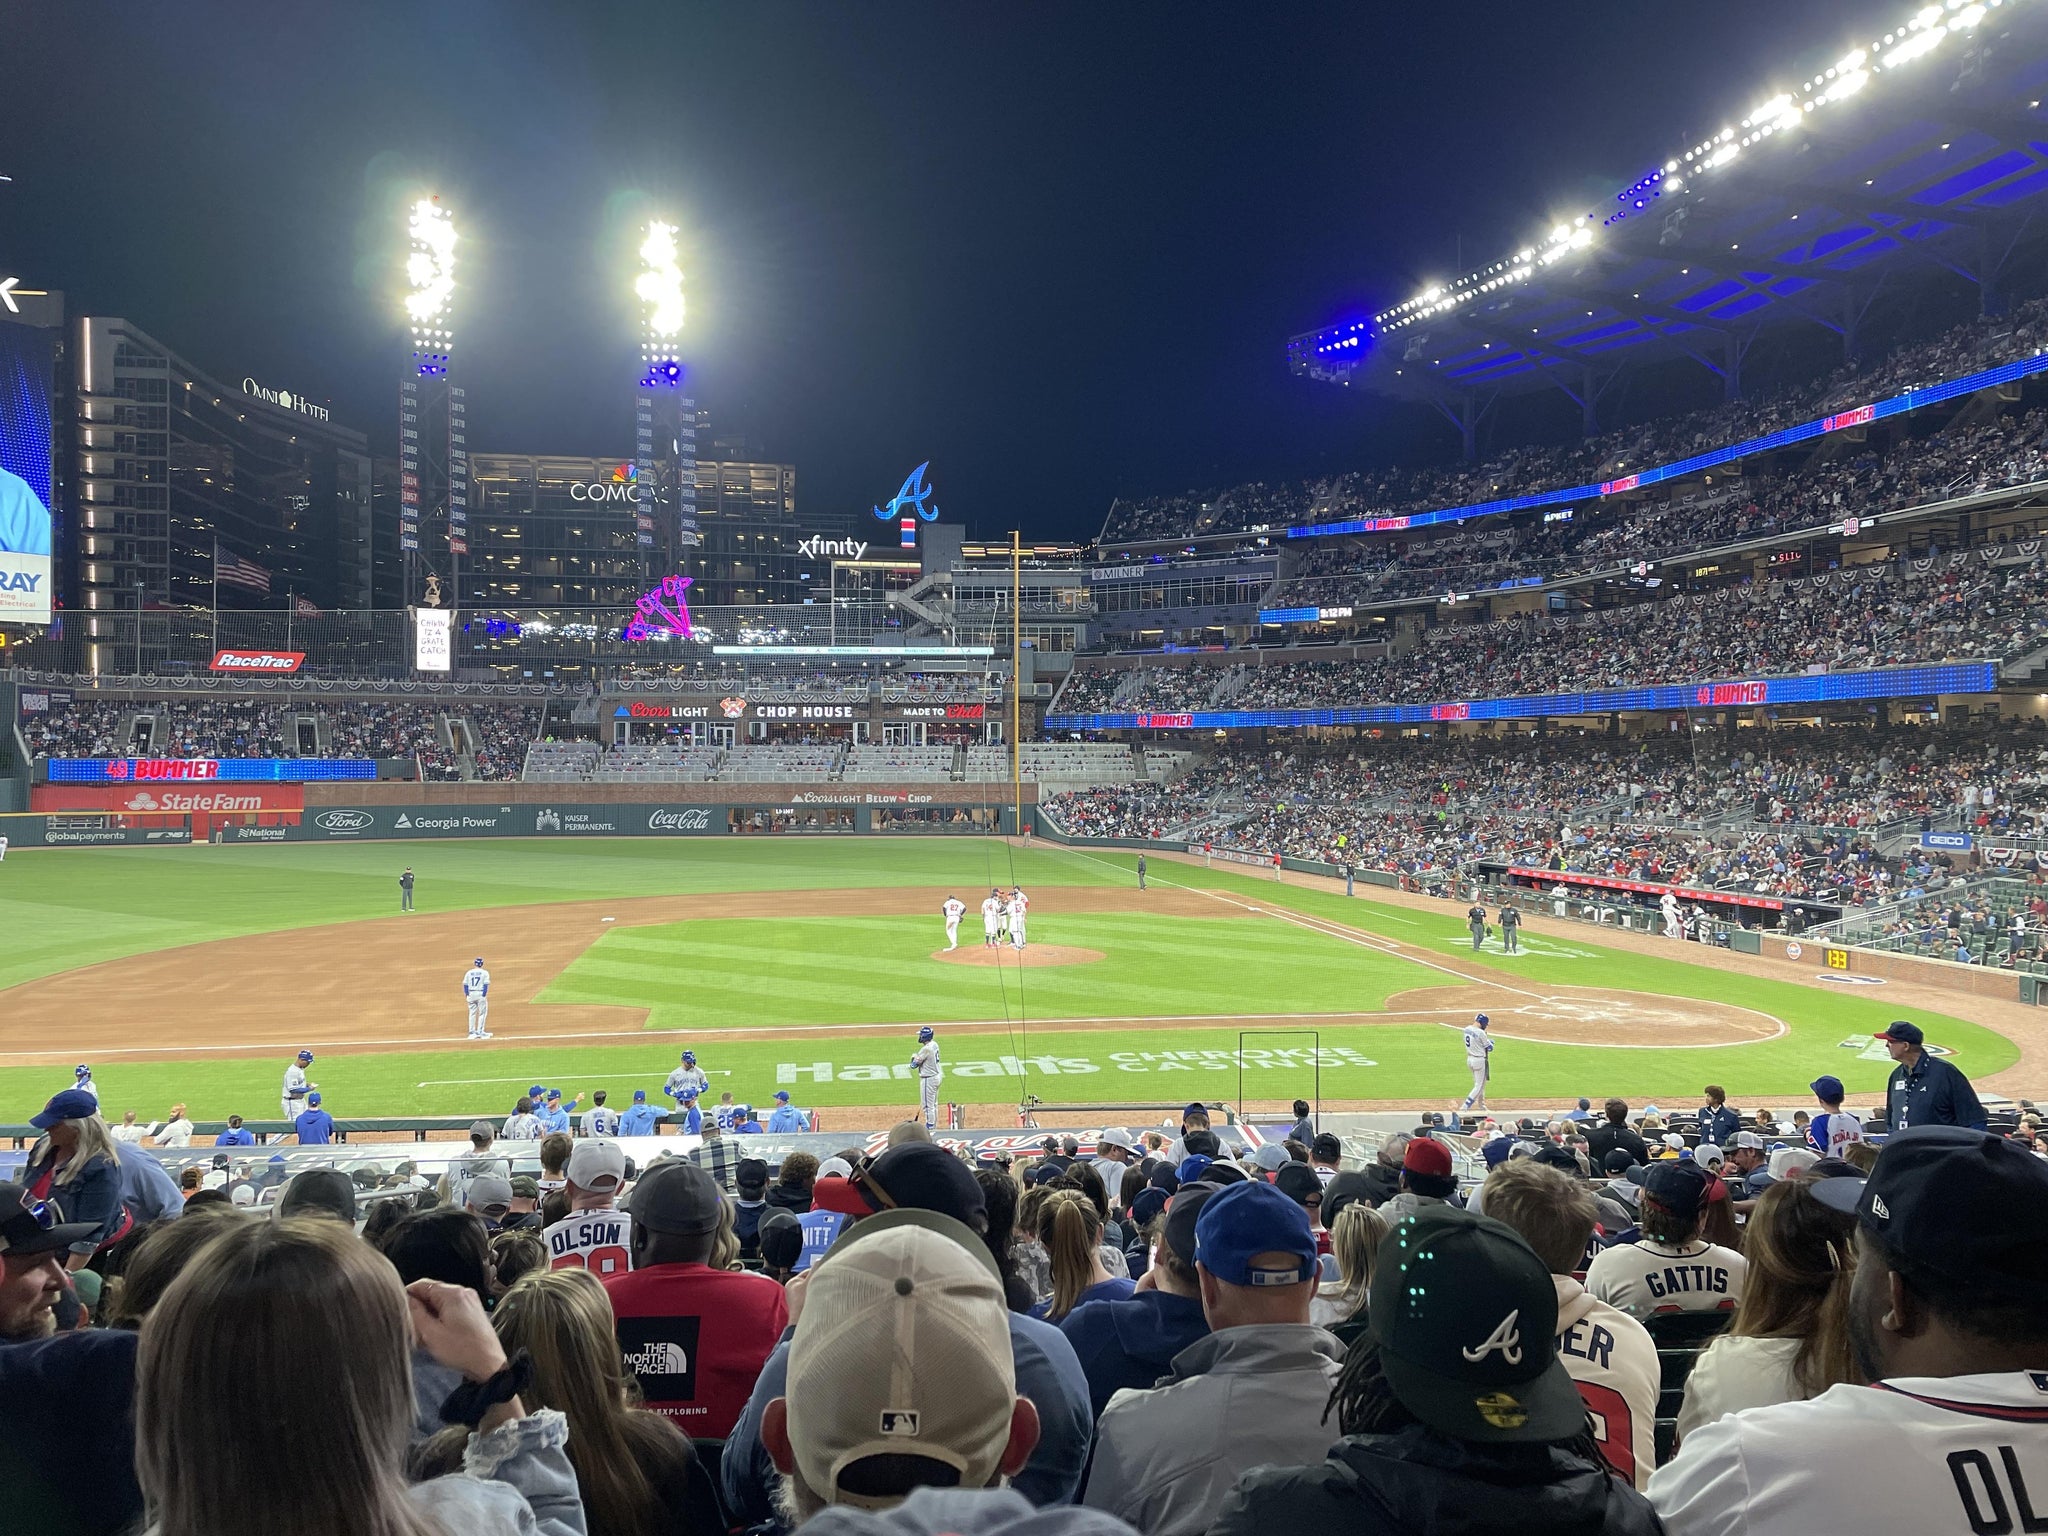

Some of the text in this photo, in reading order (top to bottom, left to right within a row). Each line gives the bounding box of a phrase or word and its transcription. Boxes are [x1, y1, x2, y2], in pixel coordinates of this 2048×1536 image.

[243, 377, 278, 404] OMNI
[1835, 406, 1875, 428] BUMMER
[403, 474, 417, 487] 1914
[682, 473, 695, 483] 2012
[1612, 474, 1639, 492] BUMMER
[403, 491, 417, 502] 1957
[570, 484, 669, 504] COMC
[403, 506, 418, 518] 1969
[403, 521, 418, 533] 1991
[682, 518, 696, 528] 2022
[1376, 517, 1410, 529] BUMMER
[1844, 517, 1859, 536] 10
[451, 525, 466, 537] 1992
[403, 537, 418, 549] 1993
[682, 533, 696, 543] 2024
[797, 535, 868, 559] xfinity
[1103, 567, 1143, 579] MILNER
[1320, 607, 1353, 618] 9:12 PM
[420, 646, 446, 654] CATCH
[217, 654, 294, 669] RaceTrac
[1714, 682, 1767, 704] BUMMER
[630, 702, 709, 718] Coors LIGHT
[756, 706, 852, 718] CHOP HOUSE
[903, 704, 985, 719] MADE TO Chill
[1150, 714, 1194, 727] BUMMER
[107, 760, 219, 779] 49 BUMMER
[803, 791, 932, 804] Coors LIGHT BELOW CHOP
[325, 812, 364, 828] Ford
[415, 817, 497, 830] Georgia Power
[649, 808, 712, 830] Coca-Cola
[249, 828, 286, 837] National
[1928, 835, 1965, 846] GEICO
[471, 976, 481, 987] 17
[1465, 1035, 1471, 1047] 9
[1108, 1047, 1359, 1063] CHEROKEE
[1116, 1058, 1379, 1073] CASINOS
[595, 1119, 604, 1133] 6
[551, 1223, 621, 1255] OLSON
[1645, 1265, 1729, 1298] GATTIS
[643, 1343, 667, 1354] THE
[1554, 1318, 1615, 1370] ER
[623, 1353, 666, 1364] NORTH
[635, 1363, 665, 1374] FACE
[656, 1407, 708, 1416] EXPLORING
[1946, 1446, 2048, 1536] OL
